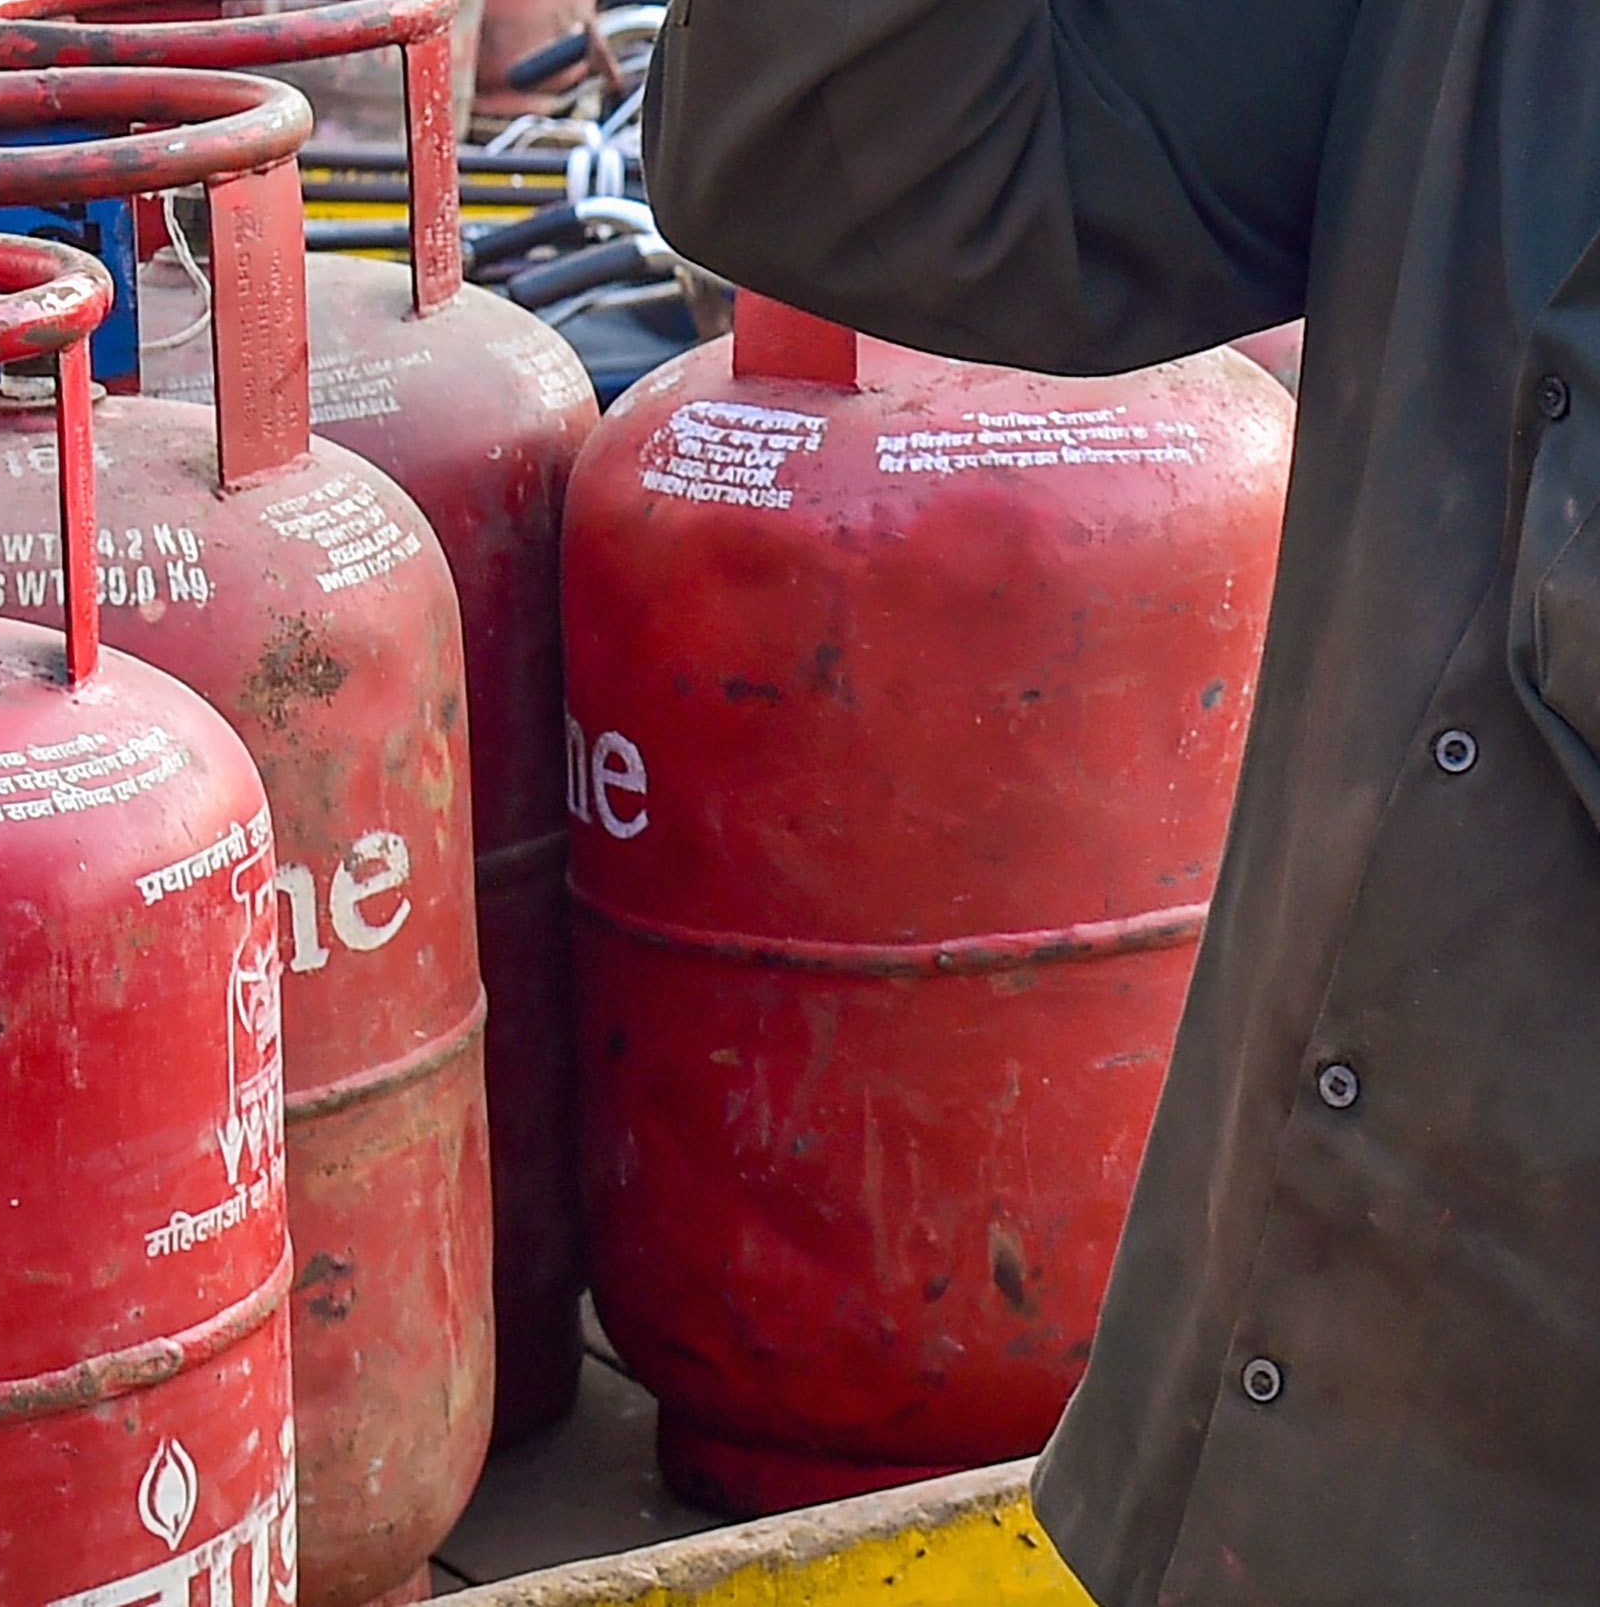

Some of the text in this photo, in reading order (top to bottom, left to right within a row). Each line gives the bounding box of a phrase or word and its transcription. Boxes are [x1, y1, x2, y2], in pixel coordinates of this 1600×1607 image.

[749, 489, 794, 510] USE
[95, 528, 143, 560] 4.2
[135, 821, 249, 906] प्रधानमंत्री
[144, 1182, 249, 1258] महिलाओं
